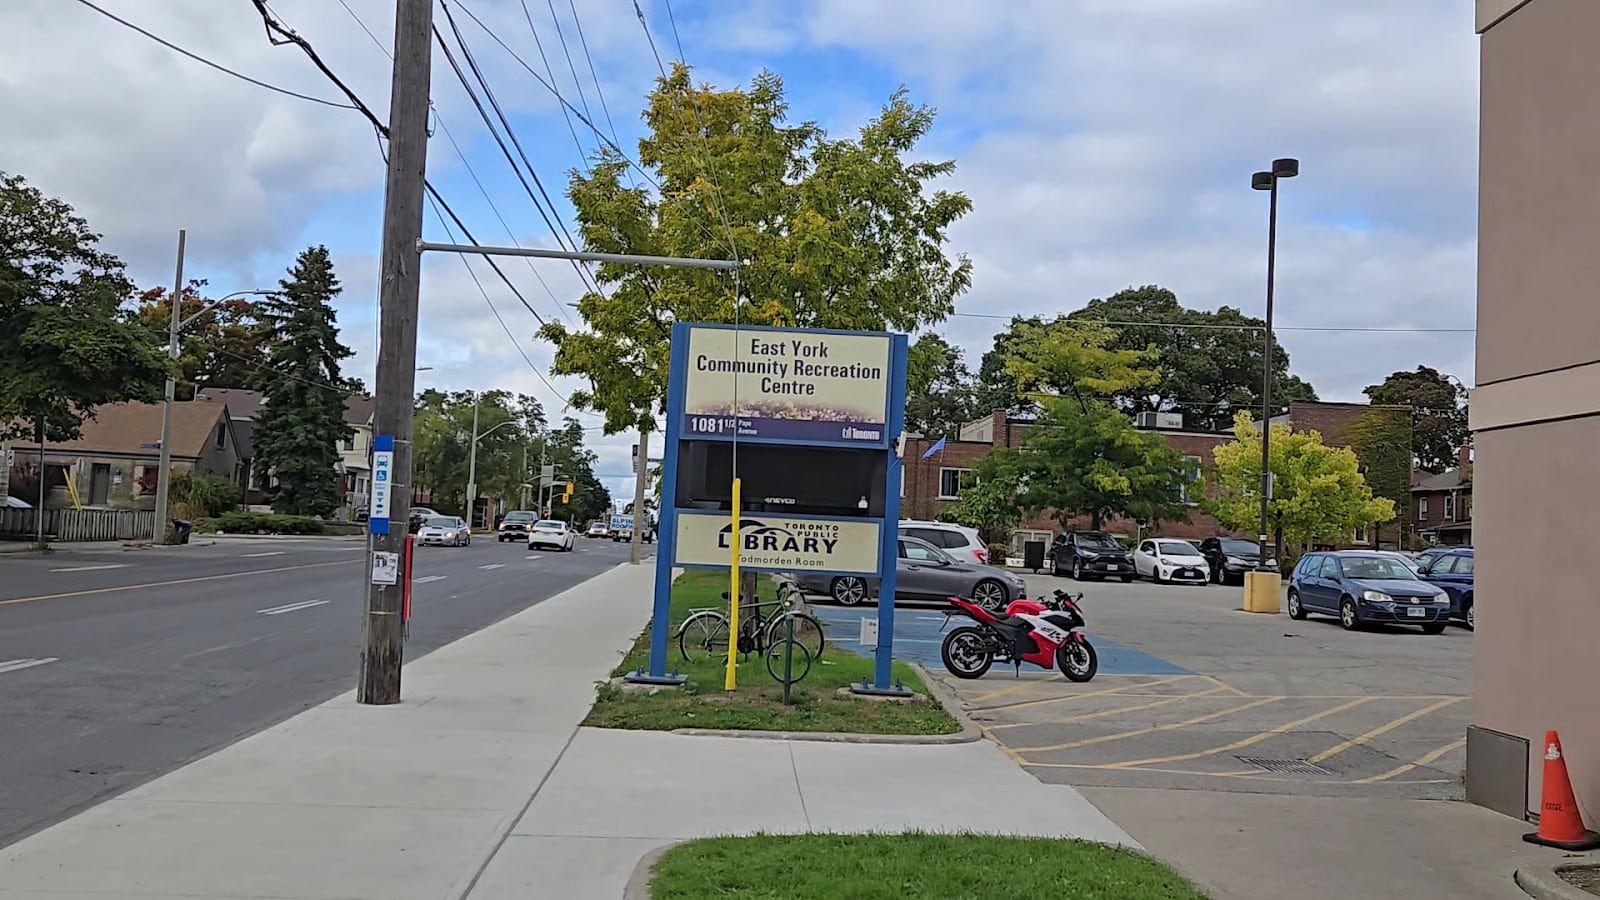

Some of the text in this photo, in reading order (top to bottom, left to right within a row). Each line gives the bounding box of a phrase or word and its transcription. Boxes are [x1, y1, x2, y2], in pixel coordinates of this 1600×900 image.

[751, 338, 829, 358] East York
[697, 354, 881, 380] Community Recreation
[761, 377, 815, 395] Centre
[784, 522, 839, 532] TORONTO
[797, 530, 839, 538] PUBLIC
[718, 532, 838, 554] LBRARY
[795, 557, 824, 566] Room
